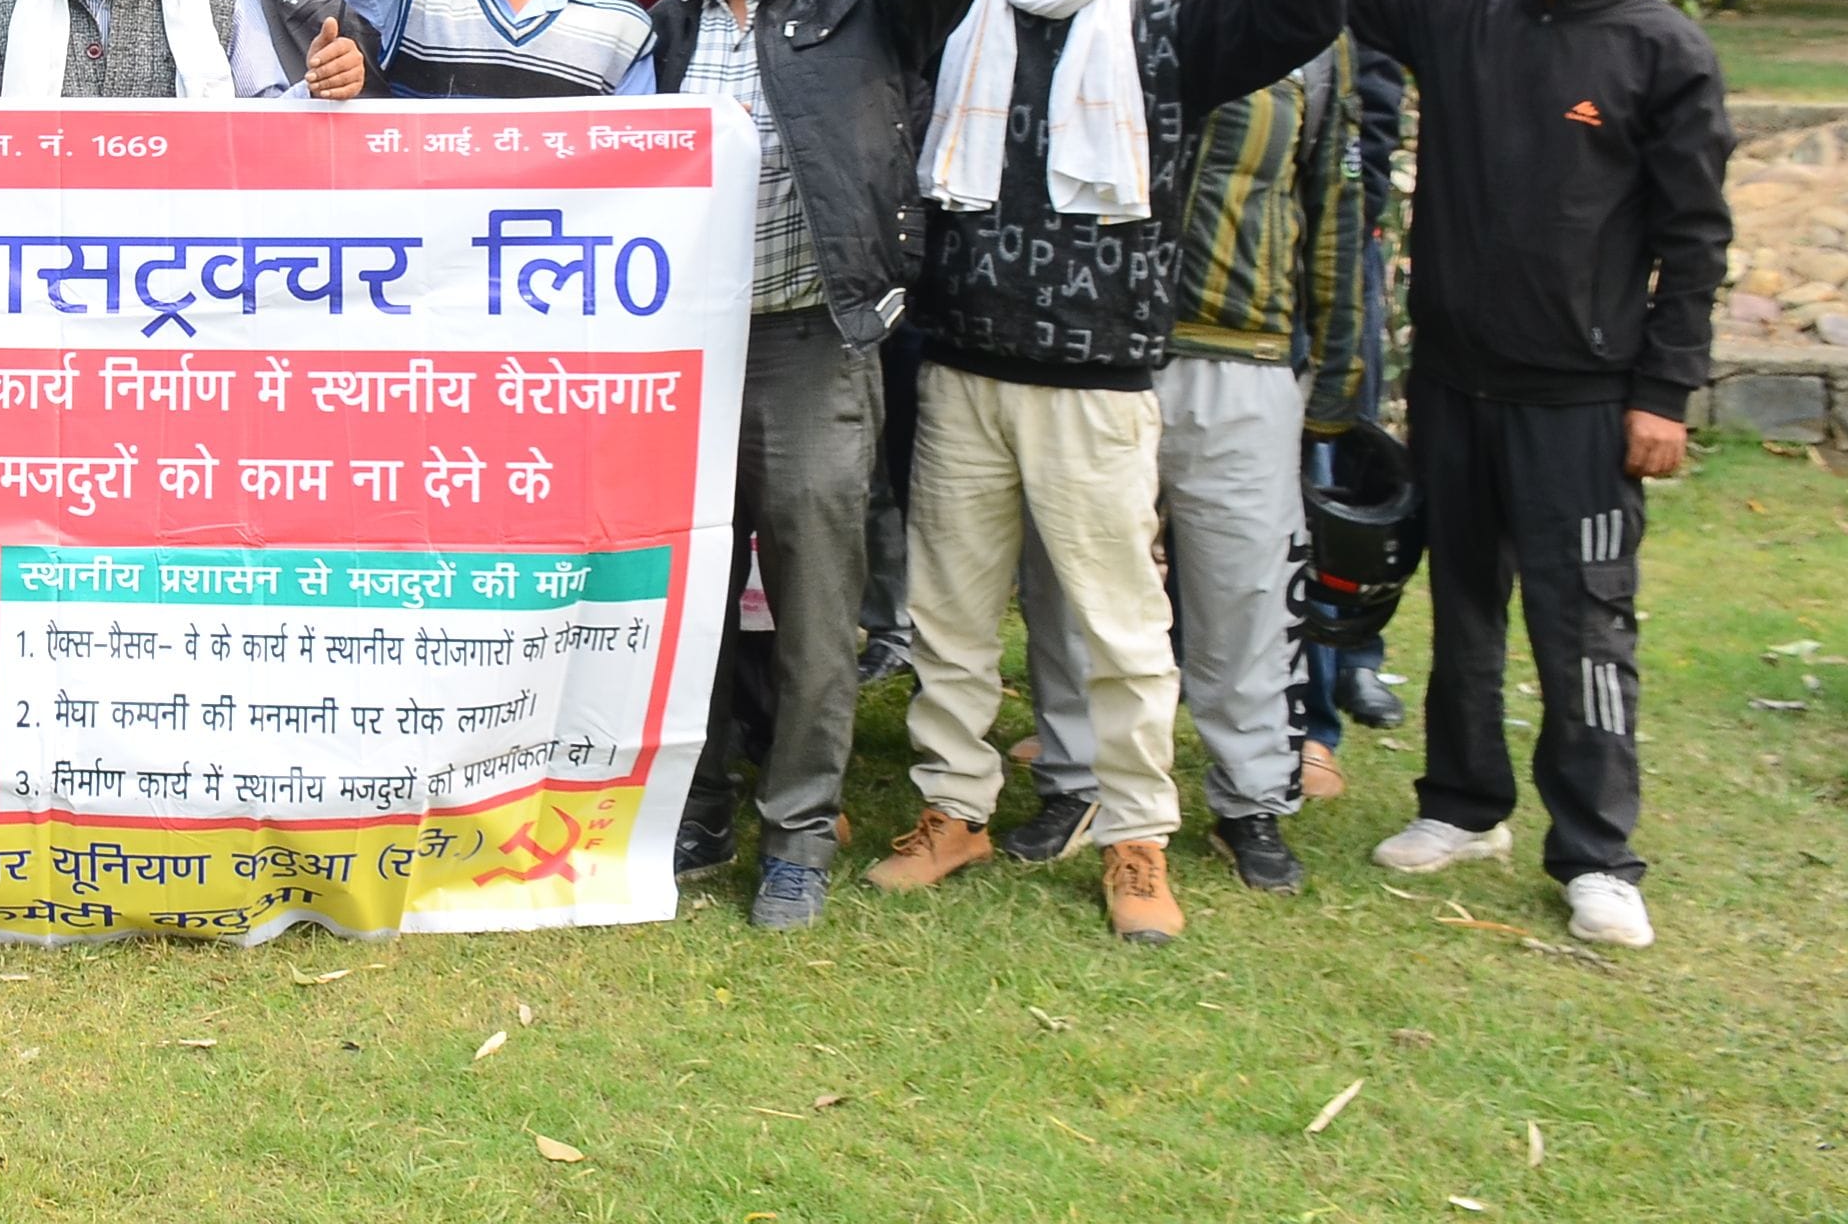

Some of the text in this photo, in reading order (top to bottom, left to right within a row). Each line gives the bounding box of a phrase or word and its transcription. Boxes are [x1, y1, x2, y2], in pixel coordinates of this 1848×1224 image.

[92, 135, 168, 157] 1669
[99, 353, 237, 411] निर्माण
[254, 355, 293, 412] में
[308, 358, 477, 414] स्थानीय
[157, 443, 220, 500] को
[238, 459, 334, 501] काम
[350, 461, 404, 502] ना
[423, 446, 486, 508] देने
[506, 446, 553, 504] के
[18, 556, 144, 592] स्थानीय
[158, 565, 282, 595] प्रशासन
[295, 558, 332, 596] से
[470, 562, 520, 599] की
[17, 630, 34, 658] 1.
[184, 623, 201, 660] वे
[210, 623, 232, 661] के
[242, 623, 288, 663] कार्य
[298, 625, 315, 663] में
[324, 628, 404, 666] स्थानीय
[523, 627, 548, 662] को
[554, 621, 620, 654] रोजगार
[16, 700, 40, 728] 2.
[54, 688, 99, 728] मैघा
[110, 693, 190, 731] कम्पनी
[201, 694, 237, 732] की
[248, 697, 339, 734] मनमानी
[351, 706, 384, 735] पर
[395, 697, 445, 735] रोक
[15, 770, 39, 796] 3.
[52, 757, 126, 798] निर्माण
[136, 761, 192, 800] कार्य
[202, 763, 224, 801] में
[232, 766, 325, 803] स्थानीय
[568, 735, 594, 767] दो
